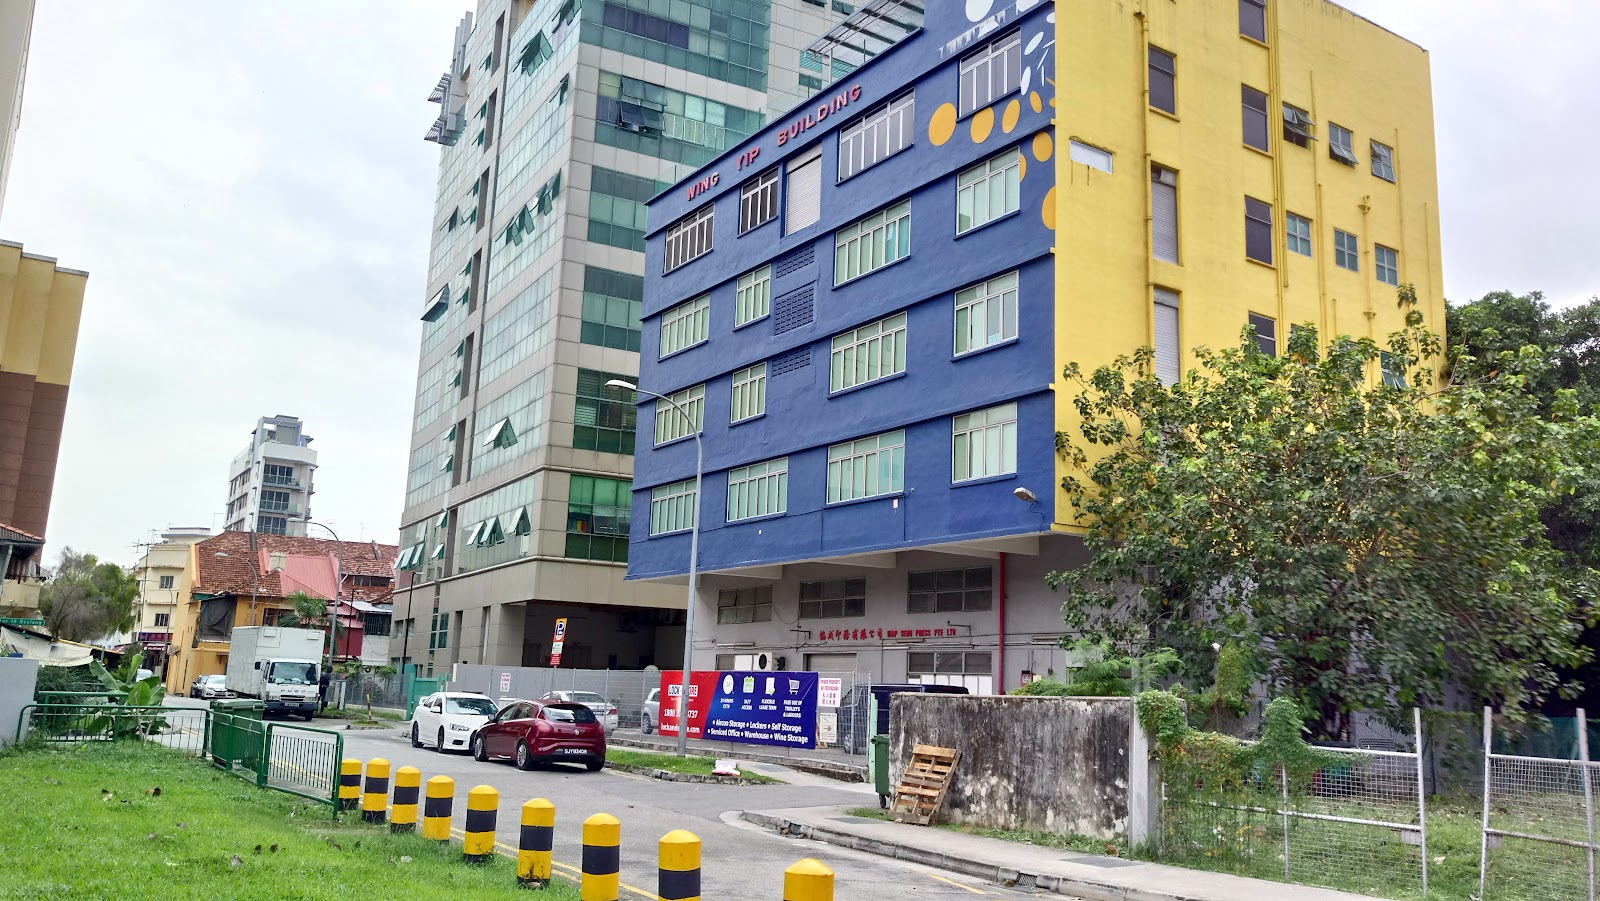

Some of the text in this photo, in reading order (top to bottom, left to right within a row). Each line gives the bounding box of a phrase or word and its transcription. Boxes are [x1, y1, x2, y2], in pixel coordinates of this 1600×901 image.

[687, 84, 862, 201] WING YIP BUILDING
[915, 629, 931, 637] PRESS
[934, 628, 943, 637] PTE
[946, 628, 956, 636] LTD
[715, 719, 802, 734] Aircon Storage Lockers Self Storage
[710, 727, 809, 745] Serviced Office Warehouse Wine Storage
